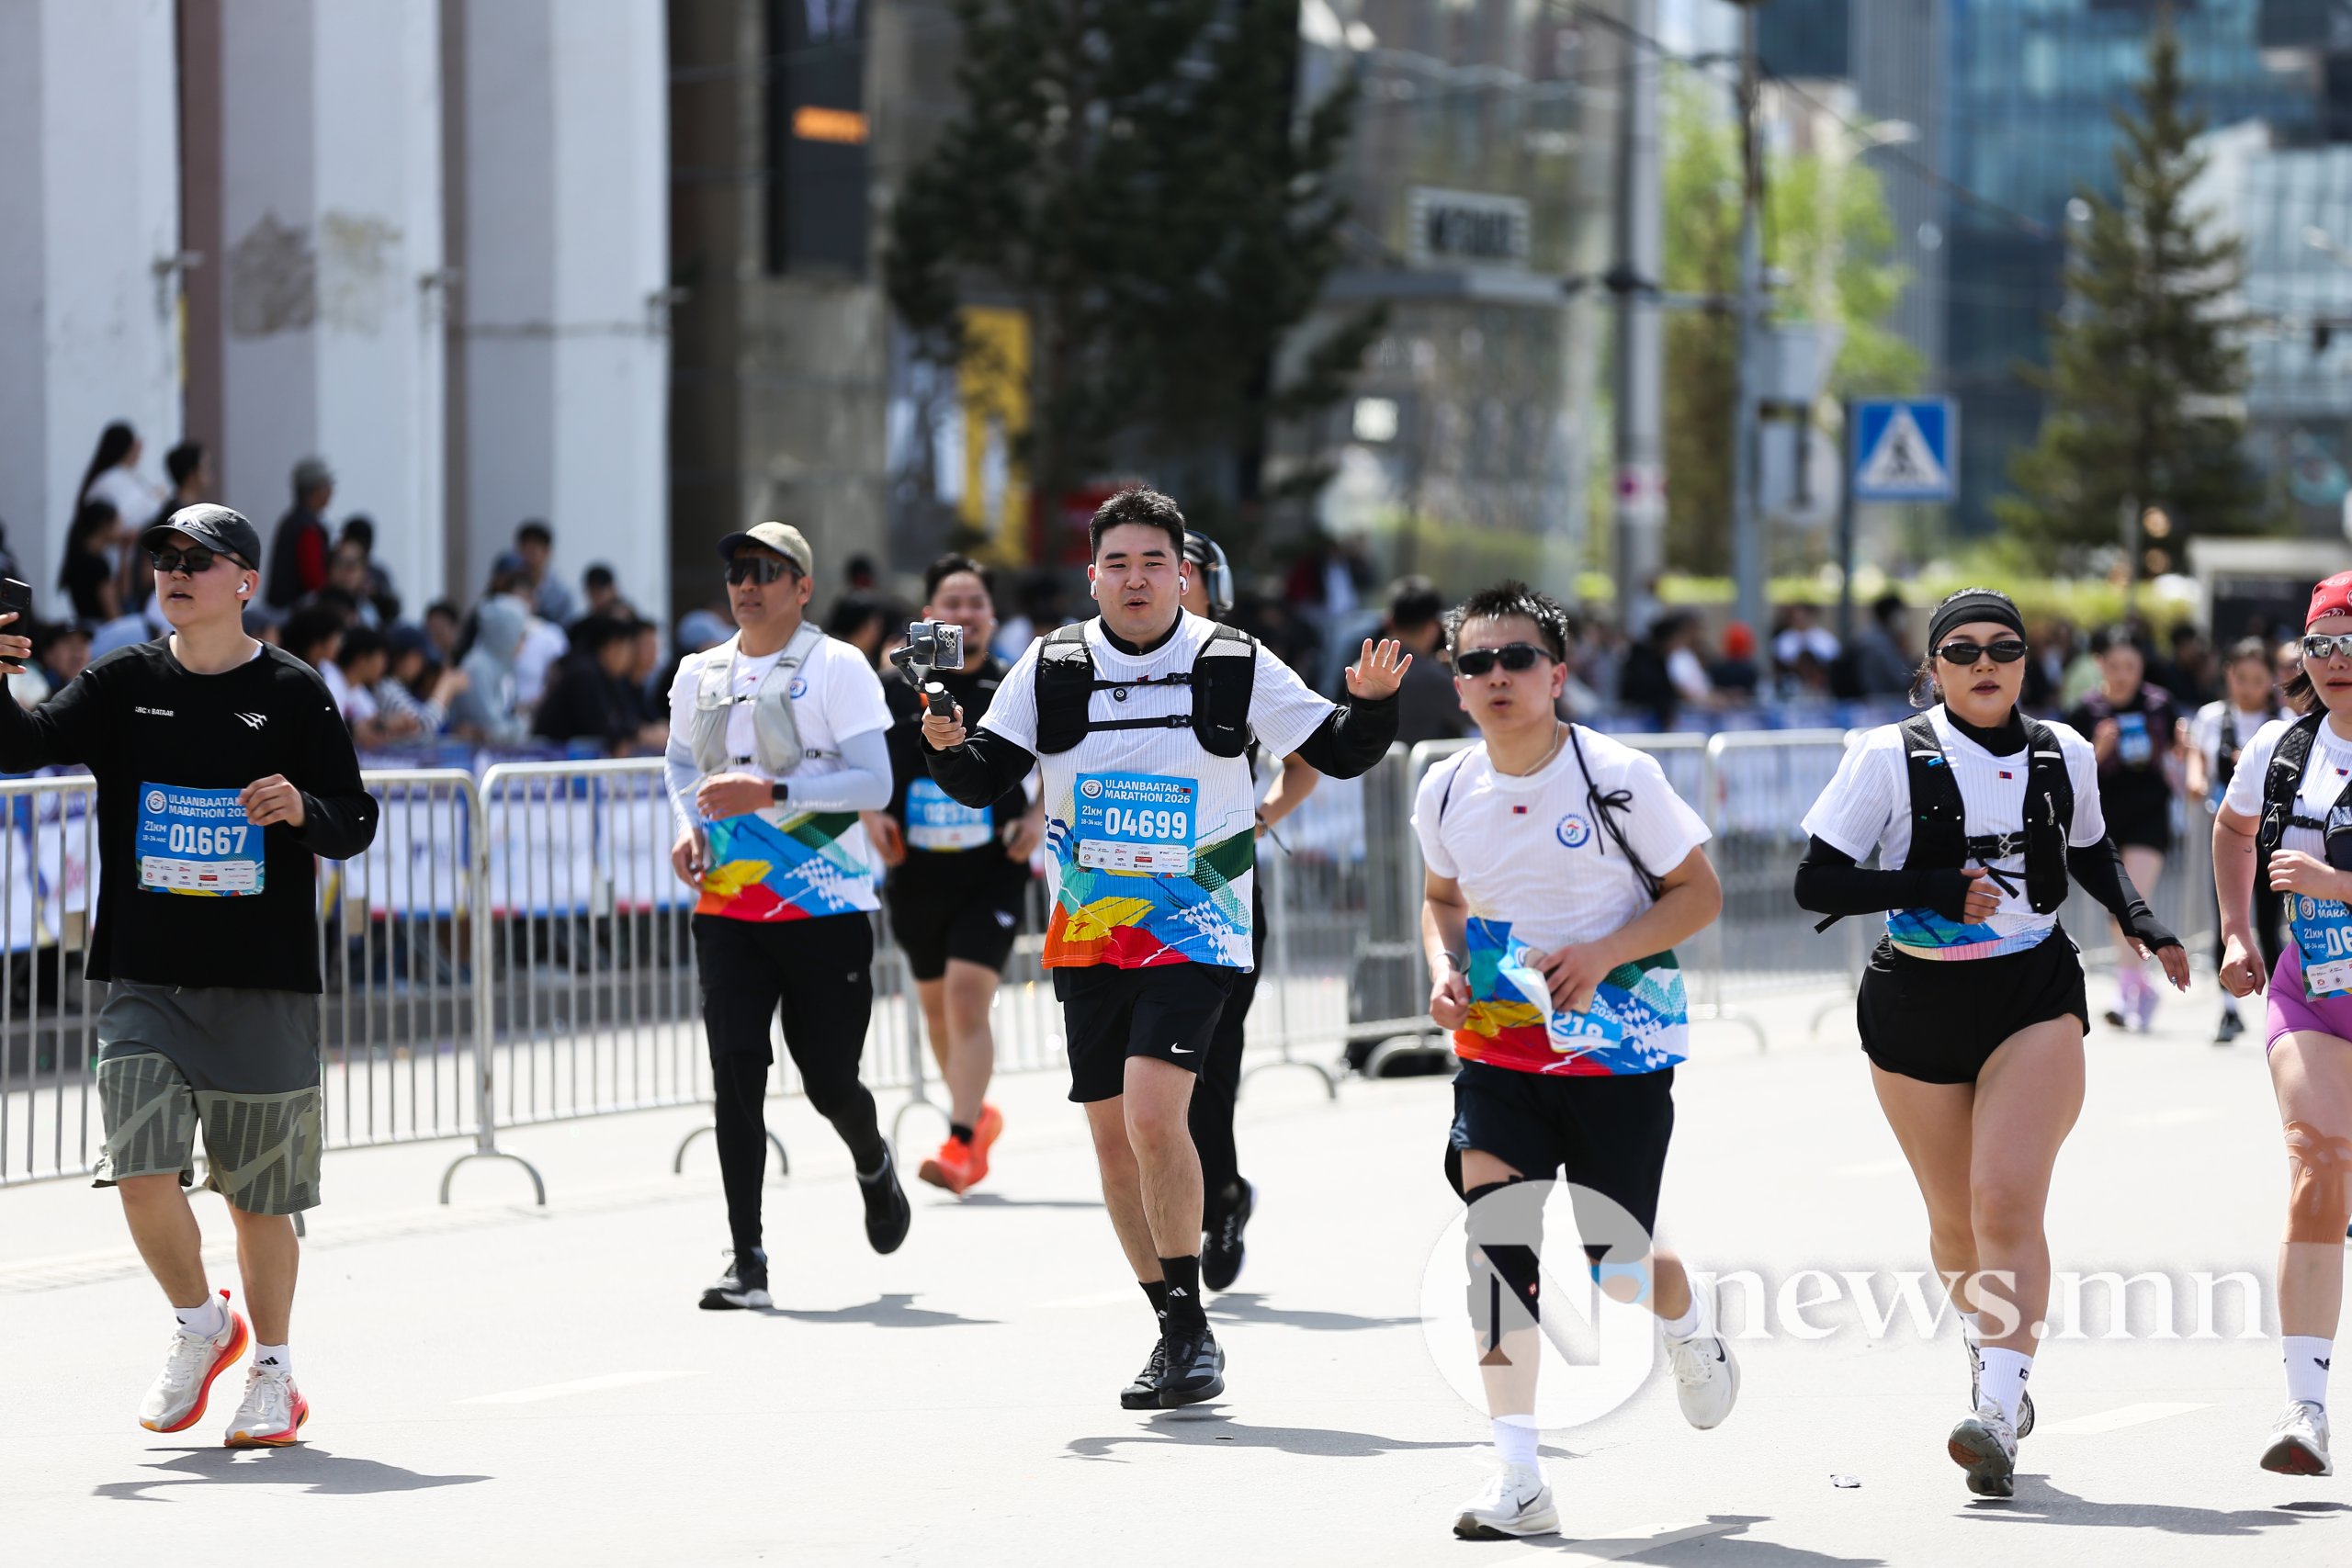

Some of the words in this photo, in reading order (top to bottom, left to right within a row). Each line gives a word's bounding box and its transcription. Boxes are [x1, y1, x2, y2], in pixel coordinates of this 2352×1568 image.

[1105, 779, 1180, 794] ULAANBAATAR
[1104, 790, 1162, 803] MARATHON
[1164, 794, 1191, 804] 2026
[168, 805, 224, 818] MARATHON
[227, 807, 248, 818] 202
[1104, 807, 1187, 840] 04699
[168, 823, 248, 855] 01667
